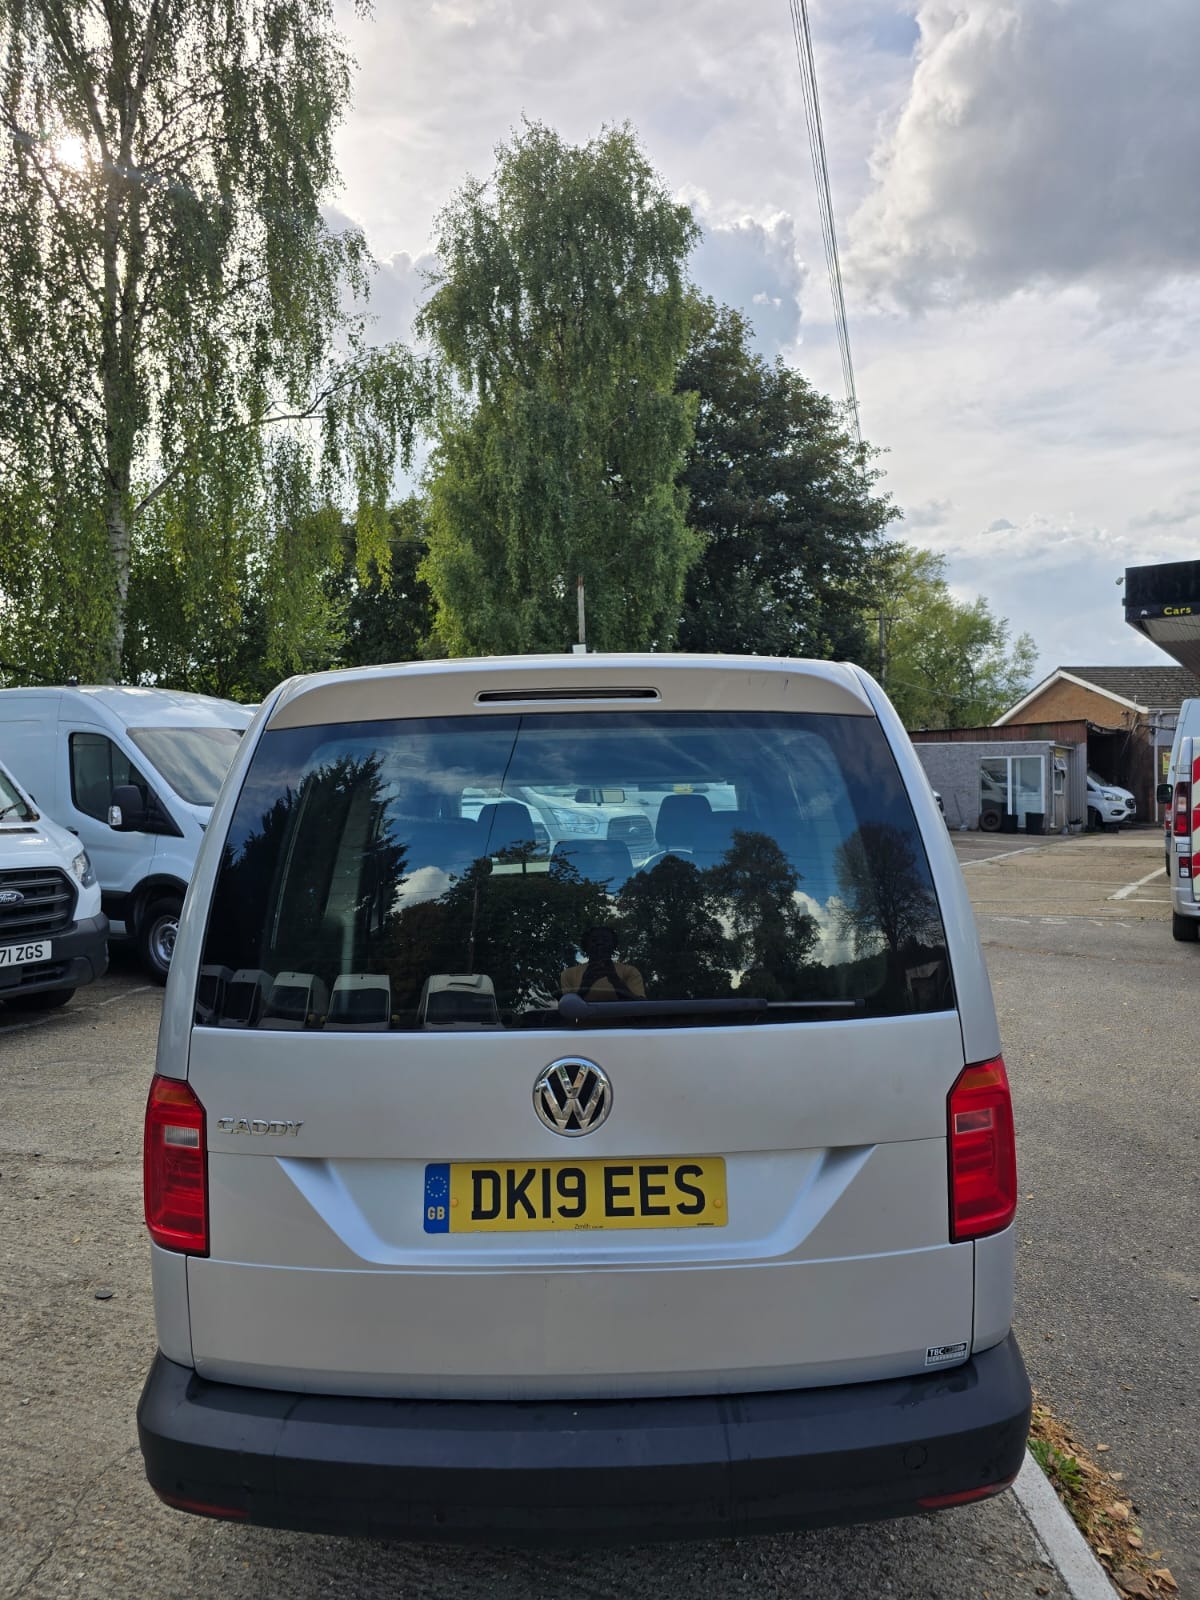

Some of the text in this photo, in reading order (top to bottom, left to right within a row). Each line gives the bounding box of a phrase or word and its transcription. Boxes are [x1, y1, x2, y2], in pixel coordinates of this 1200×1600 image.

[1163, 606, 1192, 616] Cars
[15, 944, 43, 962] ZGS
[217, 1117, 304, 1136] CADDY
[471, 1164, 706, 1220] DK19 EES
[427, 1206, 445, 1220] GB
